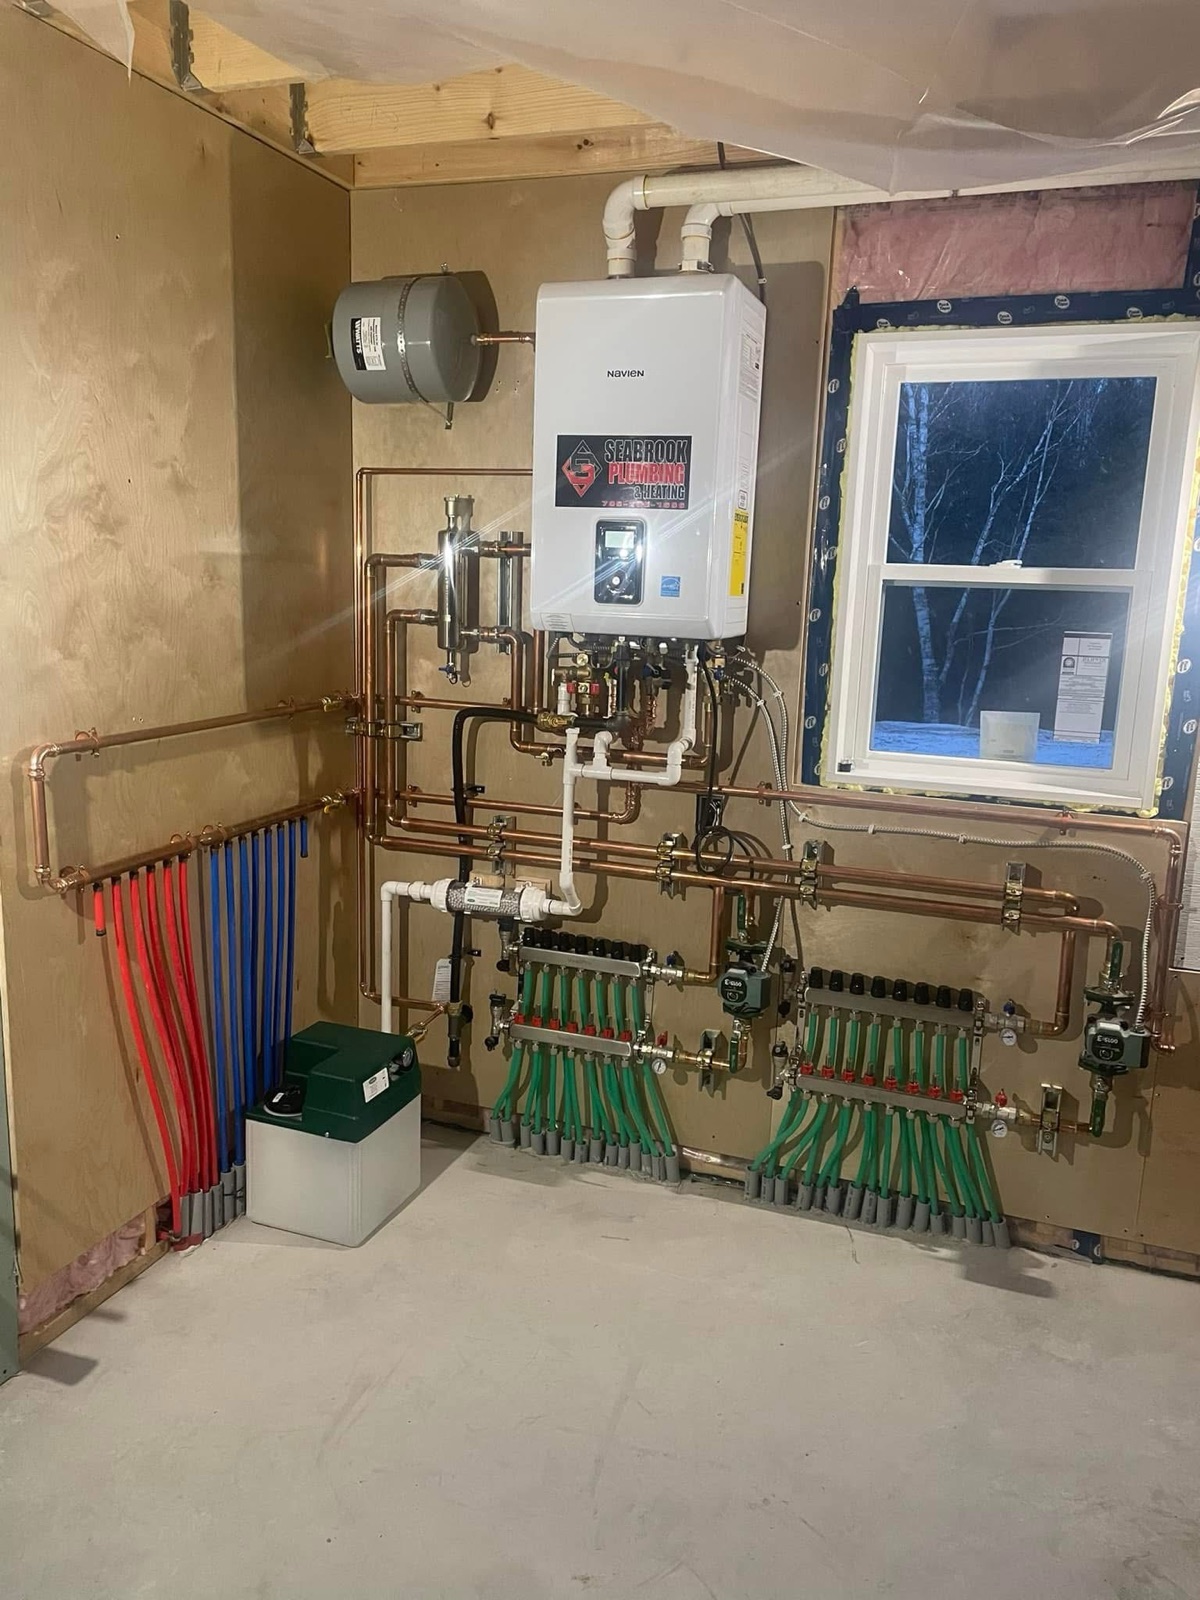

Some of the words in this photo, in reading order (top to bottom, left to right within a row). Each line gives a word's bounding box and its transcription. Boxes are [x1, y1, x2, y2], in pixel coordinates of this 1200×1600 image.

[604, 439, 688, 464] SEABROOK
[608, 462, 685, 485] PLUMBING
[634, 486, 643, 499] &
[643, 485, 685, 500] HEATING
